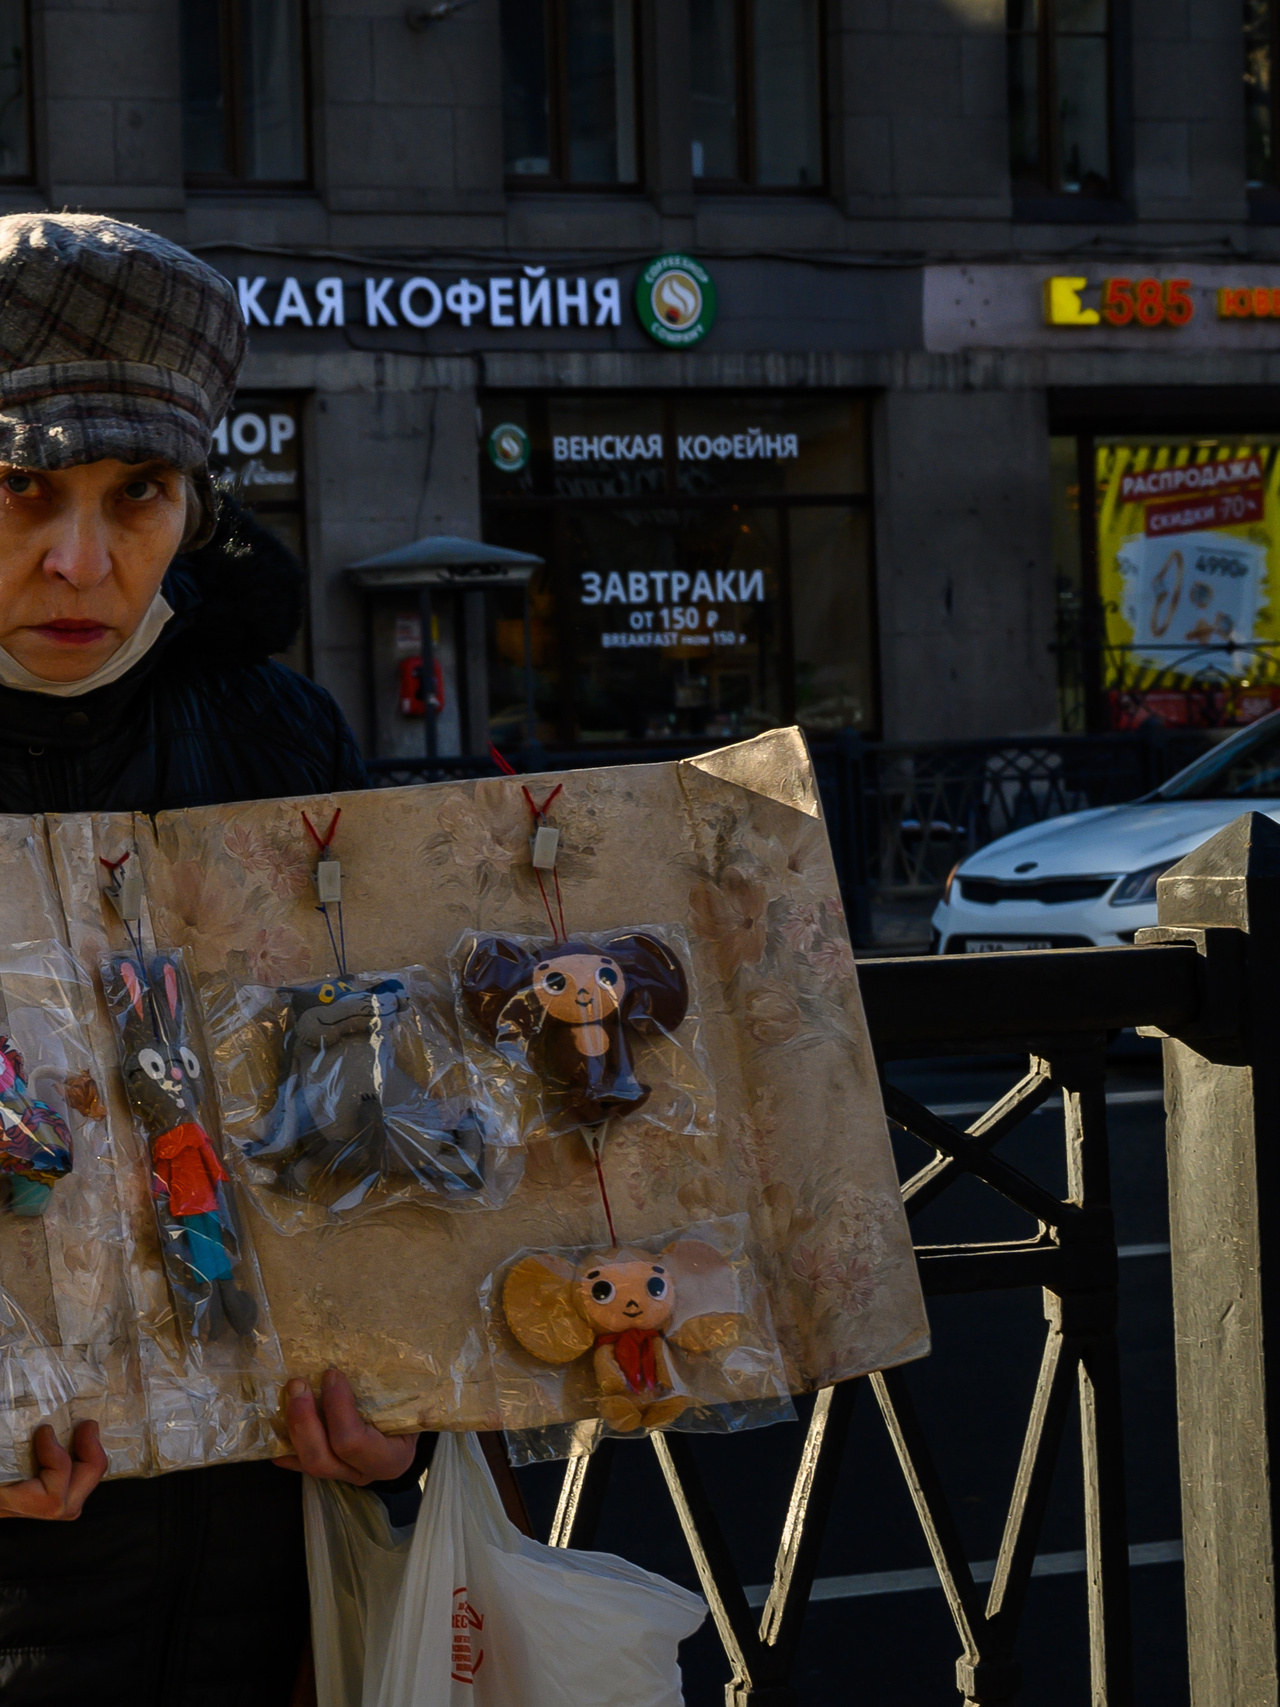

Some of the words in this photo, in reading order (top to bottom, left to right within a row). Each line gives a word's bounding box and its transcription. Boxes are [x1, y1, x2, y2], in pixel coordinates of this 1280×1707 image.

[363, 265, 622, 328] КОФЕЙНЯ
[1102, 277, 1194, 327] 585
[552, 433, 664, 462] ВЕНСКАЯ
[676, 427, 800, 461] КОФЕЙНЯ
[1121, 459, 1262, 498] РАСПРОДАЖА
[1148, 504, 1216, 532] СКИДКИ
[579, 568, 766, 607] ЗАВТРАКИ
[628, 610, 655, 631] ОТ
[658, 605, 701, 631] 150
